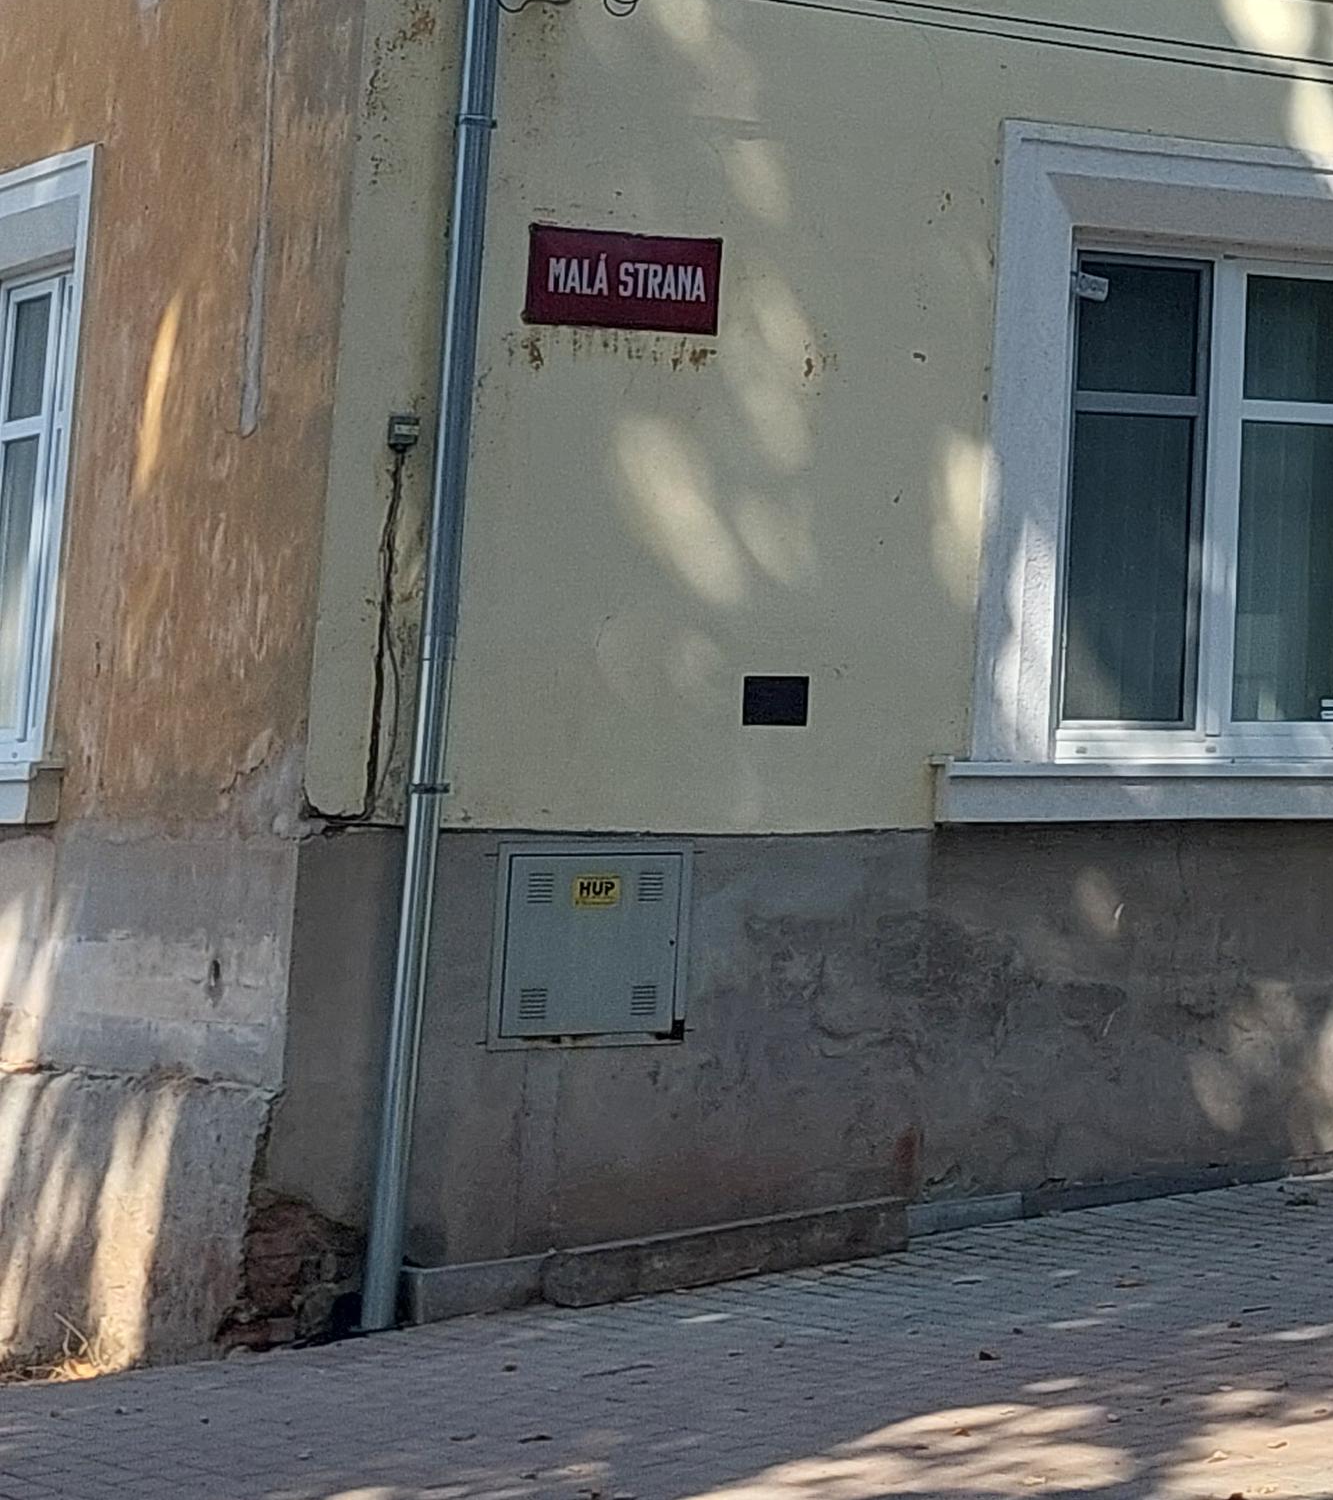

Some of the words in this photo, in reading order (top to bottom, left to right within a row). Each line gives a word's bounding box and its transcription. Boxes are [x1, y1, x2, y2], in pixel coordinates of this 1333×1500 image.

[547, 253, 609, 297] MALÁ
[618, 261, 706, 303] STRANA
[579, 880, 616, 897] HUP
